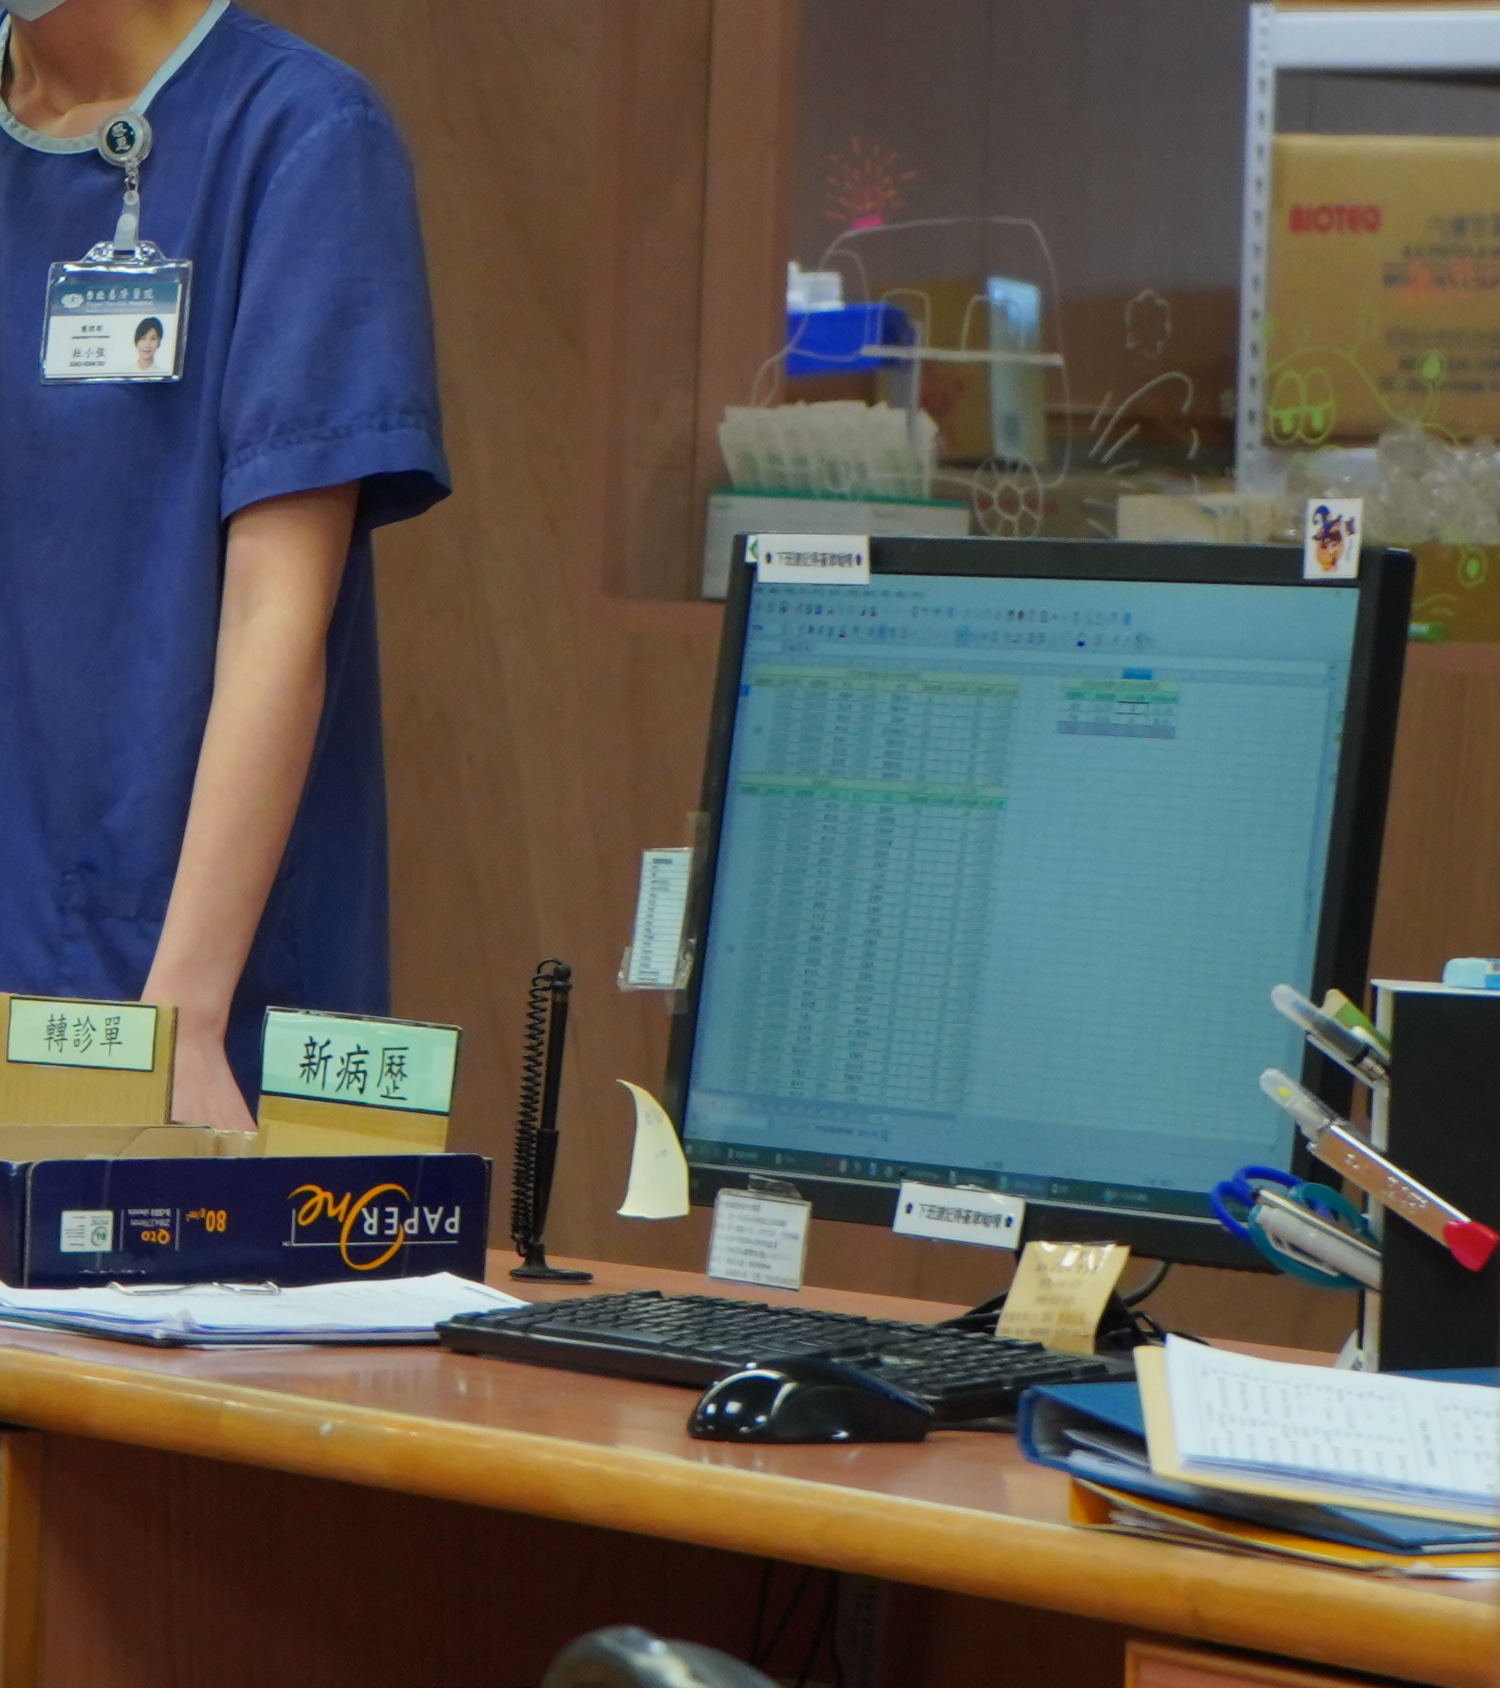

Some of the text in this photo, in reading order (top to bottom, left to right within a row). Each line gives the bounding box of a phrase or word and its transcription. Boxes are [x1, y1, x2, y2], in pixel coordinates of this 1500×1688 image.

[43, 1013, 123, 1058] 轉診單
[299, 1035, 409, 1103] 新病歷
[141, 1228, 171, 1244] Qto
[204, 1208, 227, 1232] 80
[287, 1183, 462, 1271] PAPER One
